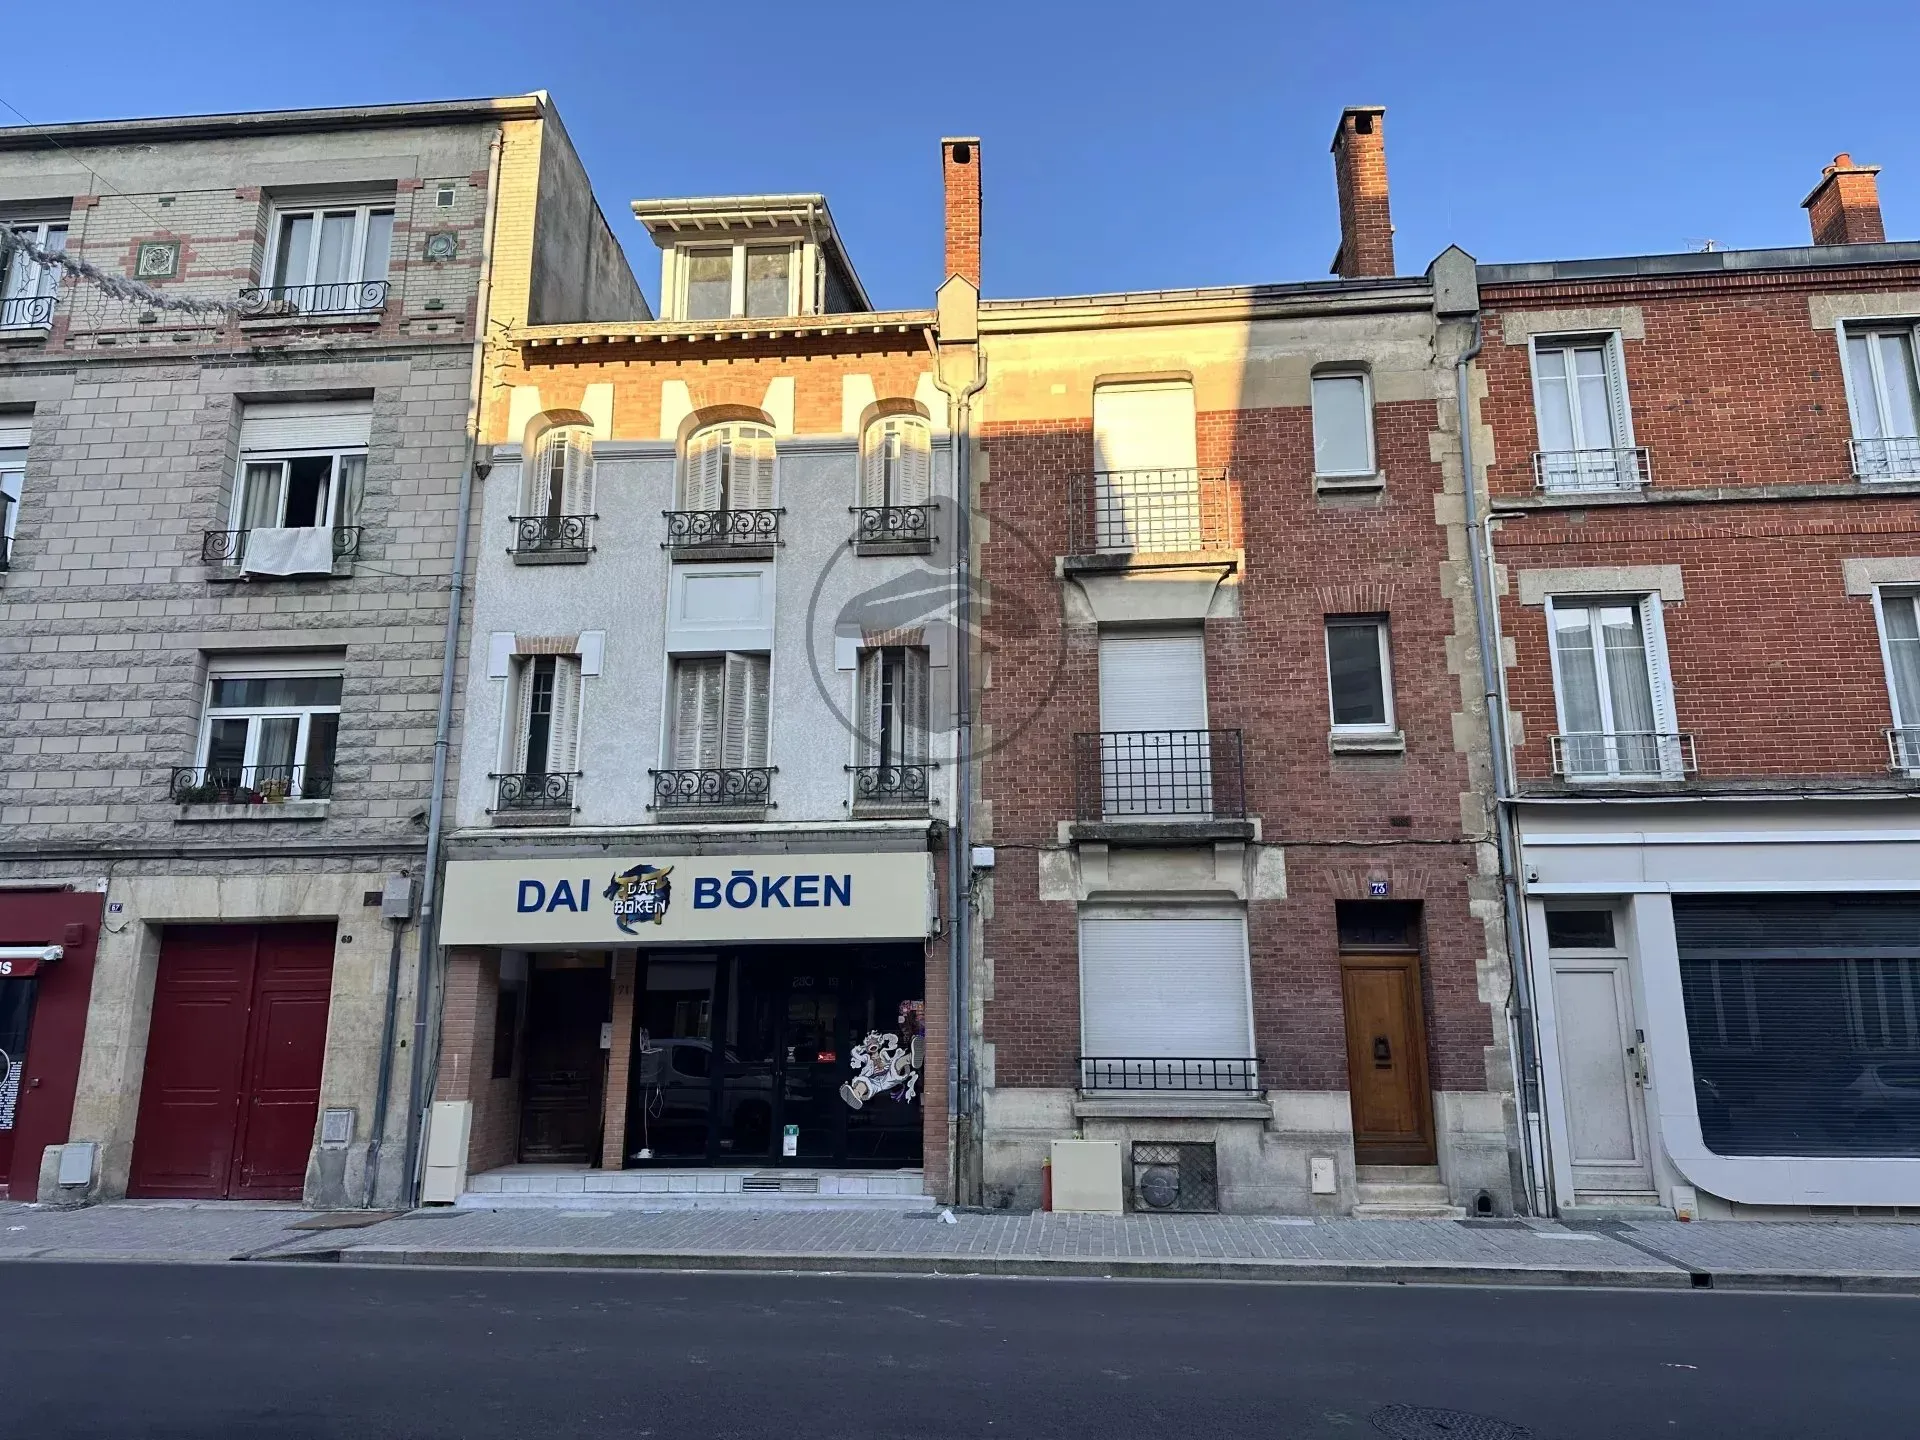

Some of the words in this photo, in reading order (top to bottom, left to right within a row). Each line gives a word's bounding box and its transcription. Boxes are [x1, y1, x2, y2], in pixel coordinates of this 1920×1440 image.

[517, 879, 591, 912] DAI
[693, 870, 851, 909] BŌKEN
[627, 882, 657, 894] DAI
[1371, 883, 1386, 894] 73
[0, 961, 12, 974] S
